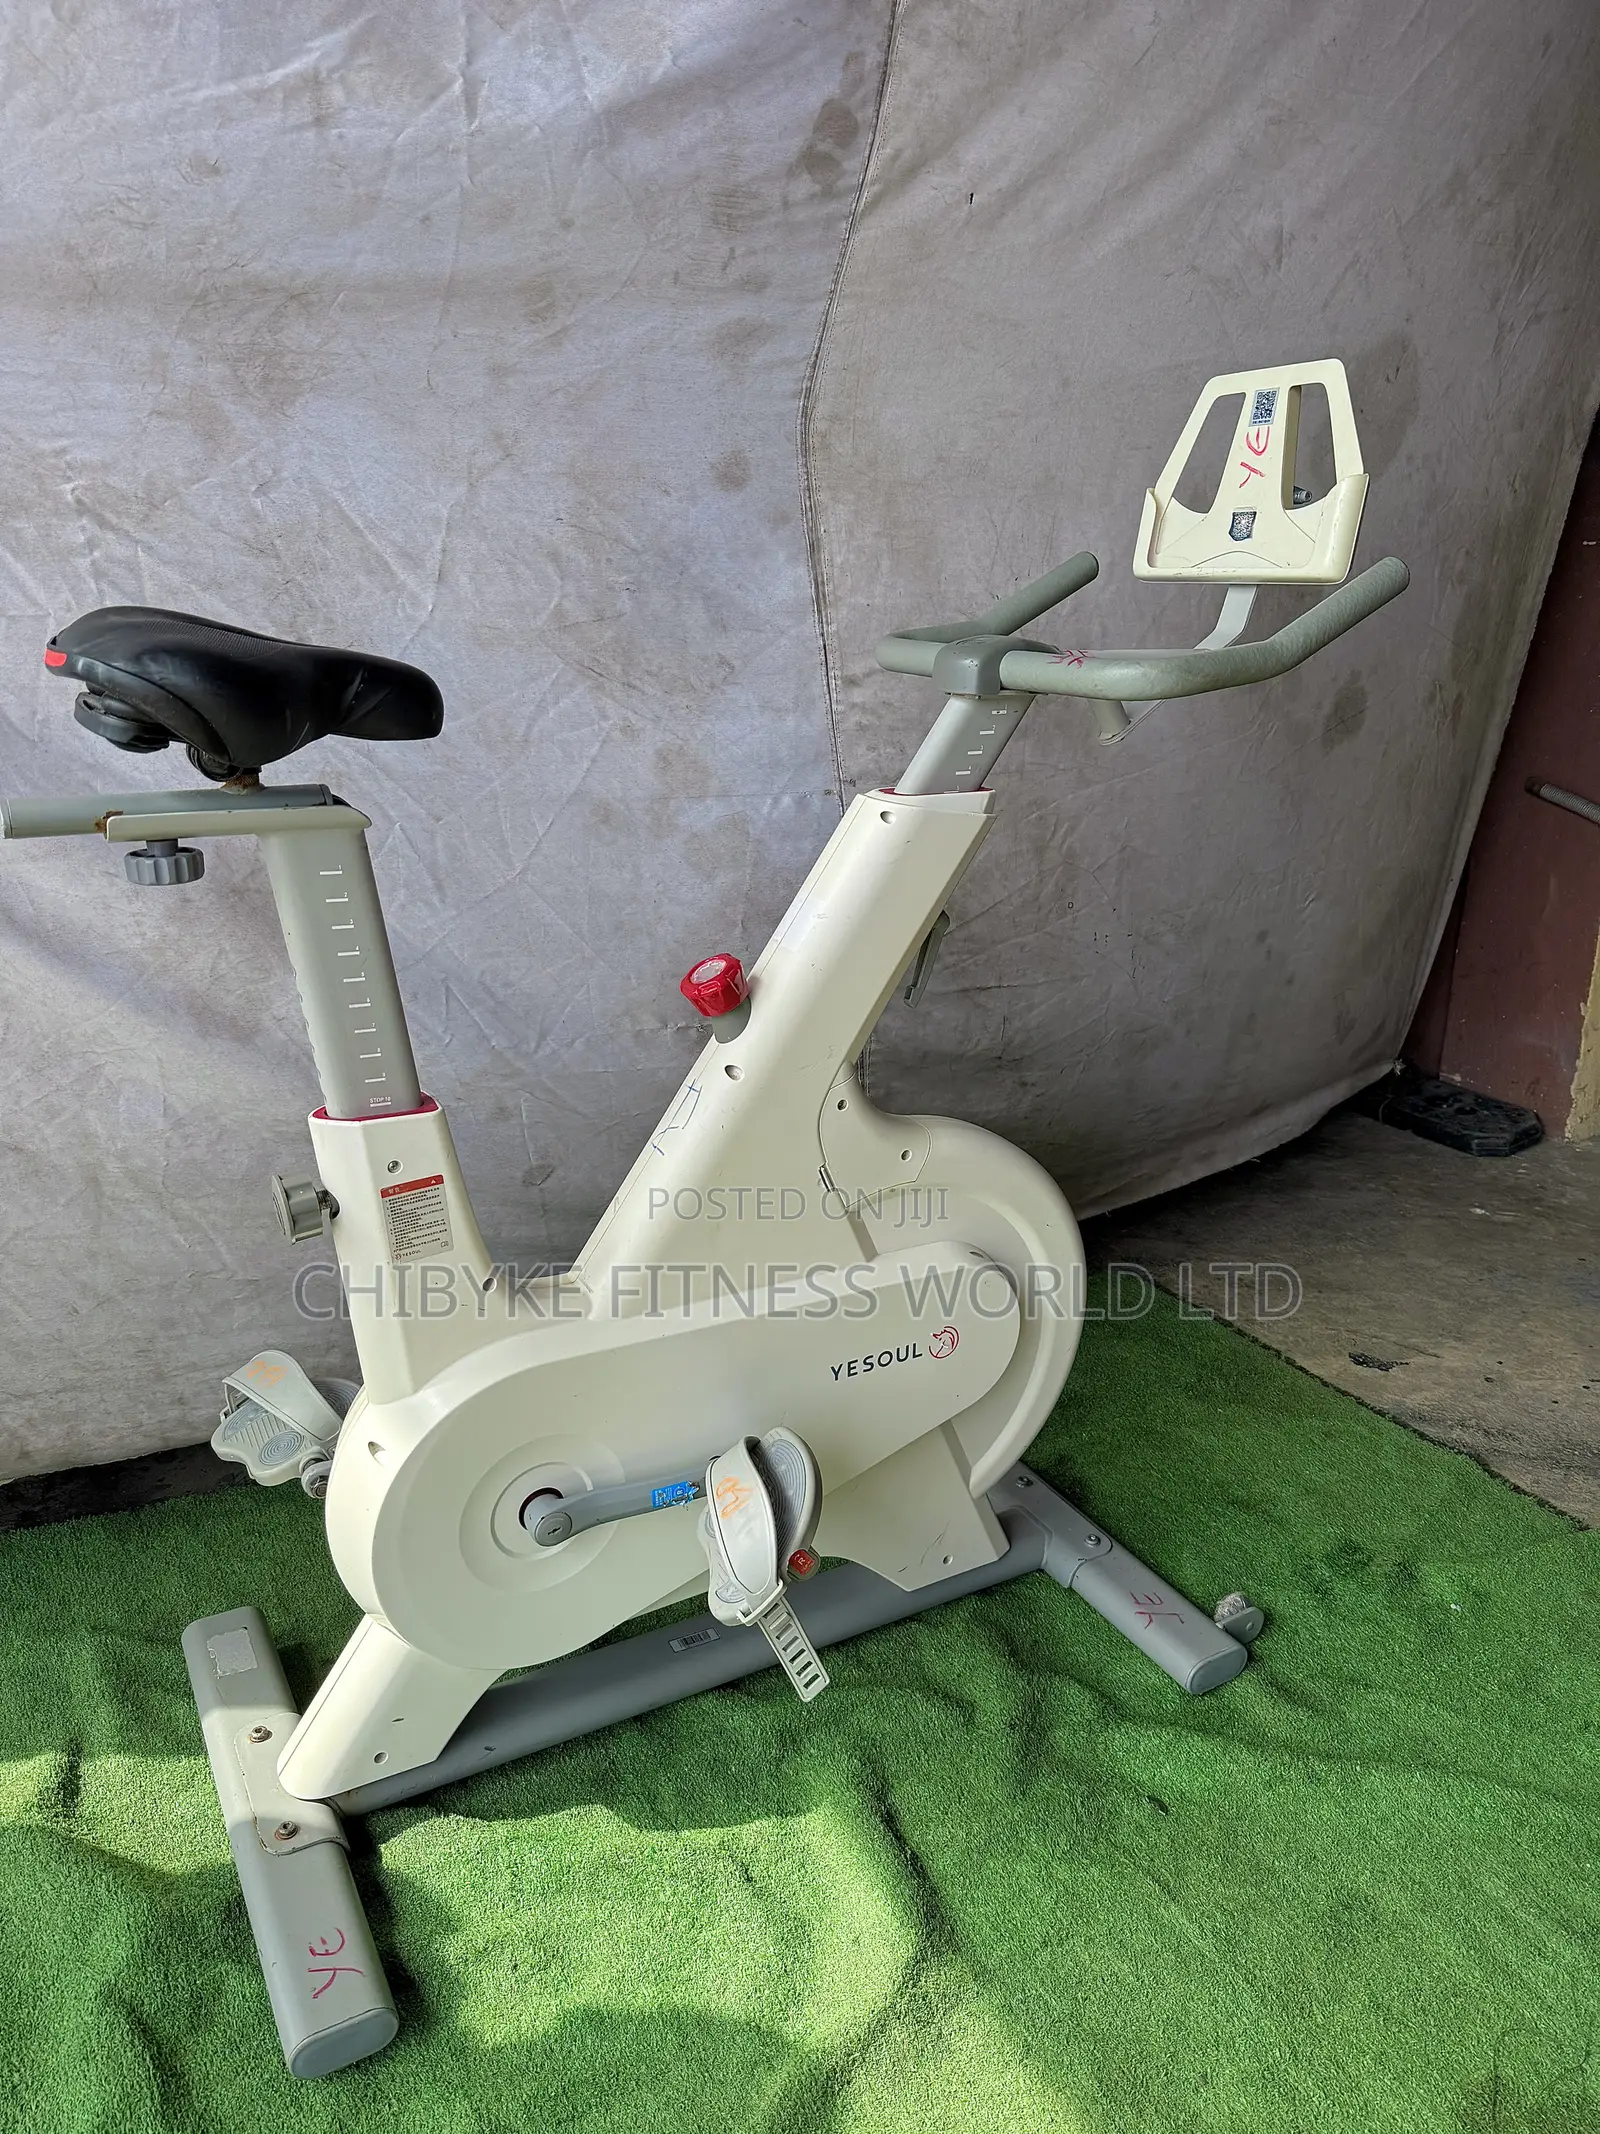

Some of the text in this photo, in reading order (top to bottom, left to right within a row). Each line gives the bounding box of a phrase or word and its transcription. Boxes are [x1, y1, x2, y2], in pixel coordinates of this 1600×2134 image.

[369, 1096, 385, 1104] STOP
[402, 1249, 422, 1257] YESOUL
[830, 1342, 923, 1382] YESOUL
